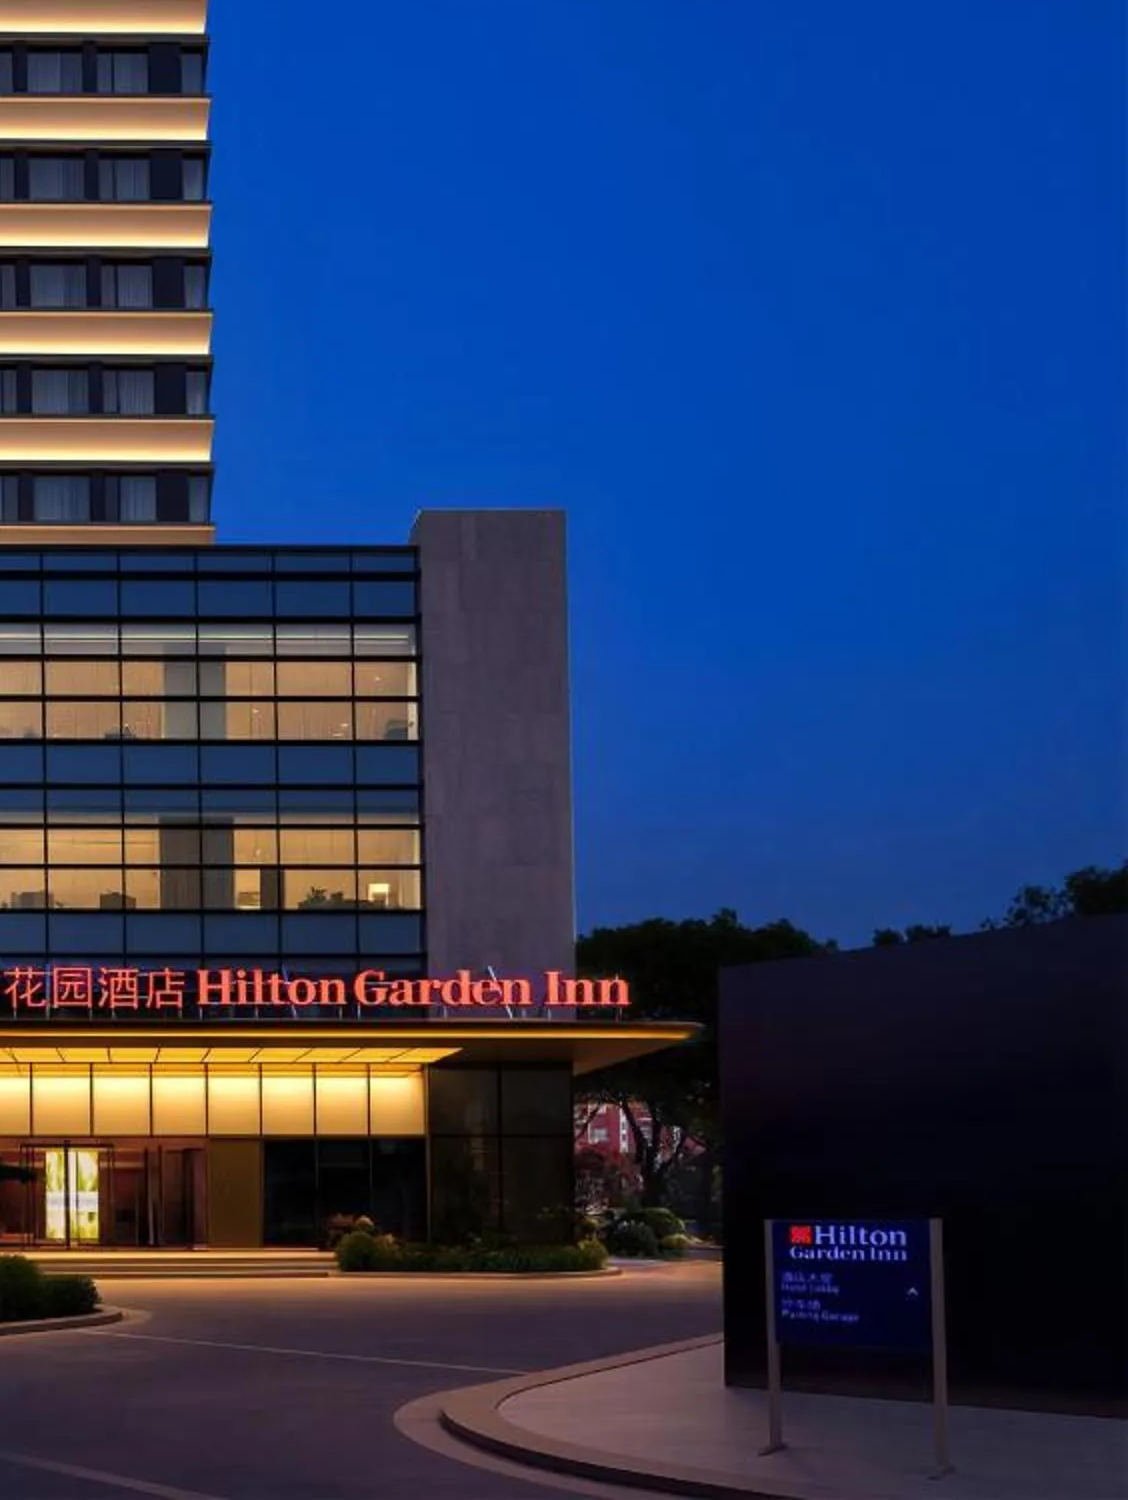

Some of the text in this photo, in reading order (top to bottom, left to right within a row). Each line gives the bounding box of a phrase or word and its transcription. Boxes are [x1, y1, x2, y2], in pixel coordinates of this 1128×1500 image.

[197, 969, 631, 1008] Hilton Garden Inn
[814, 1225, 907, 1246] Hilton
[789, 1246, 908, 1261] Garden Inn
